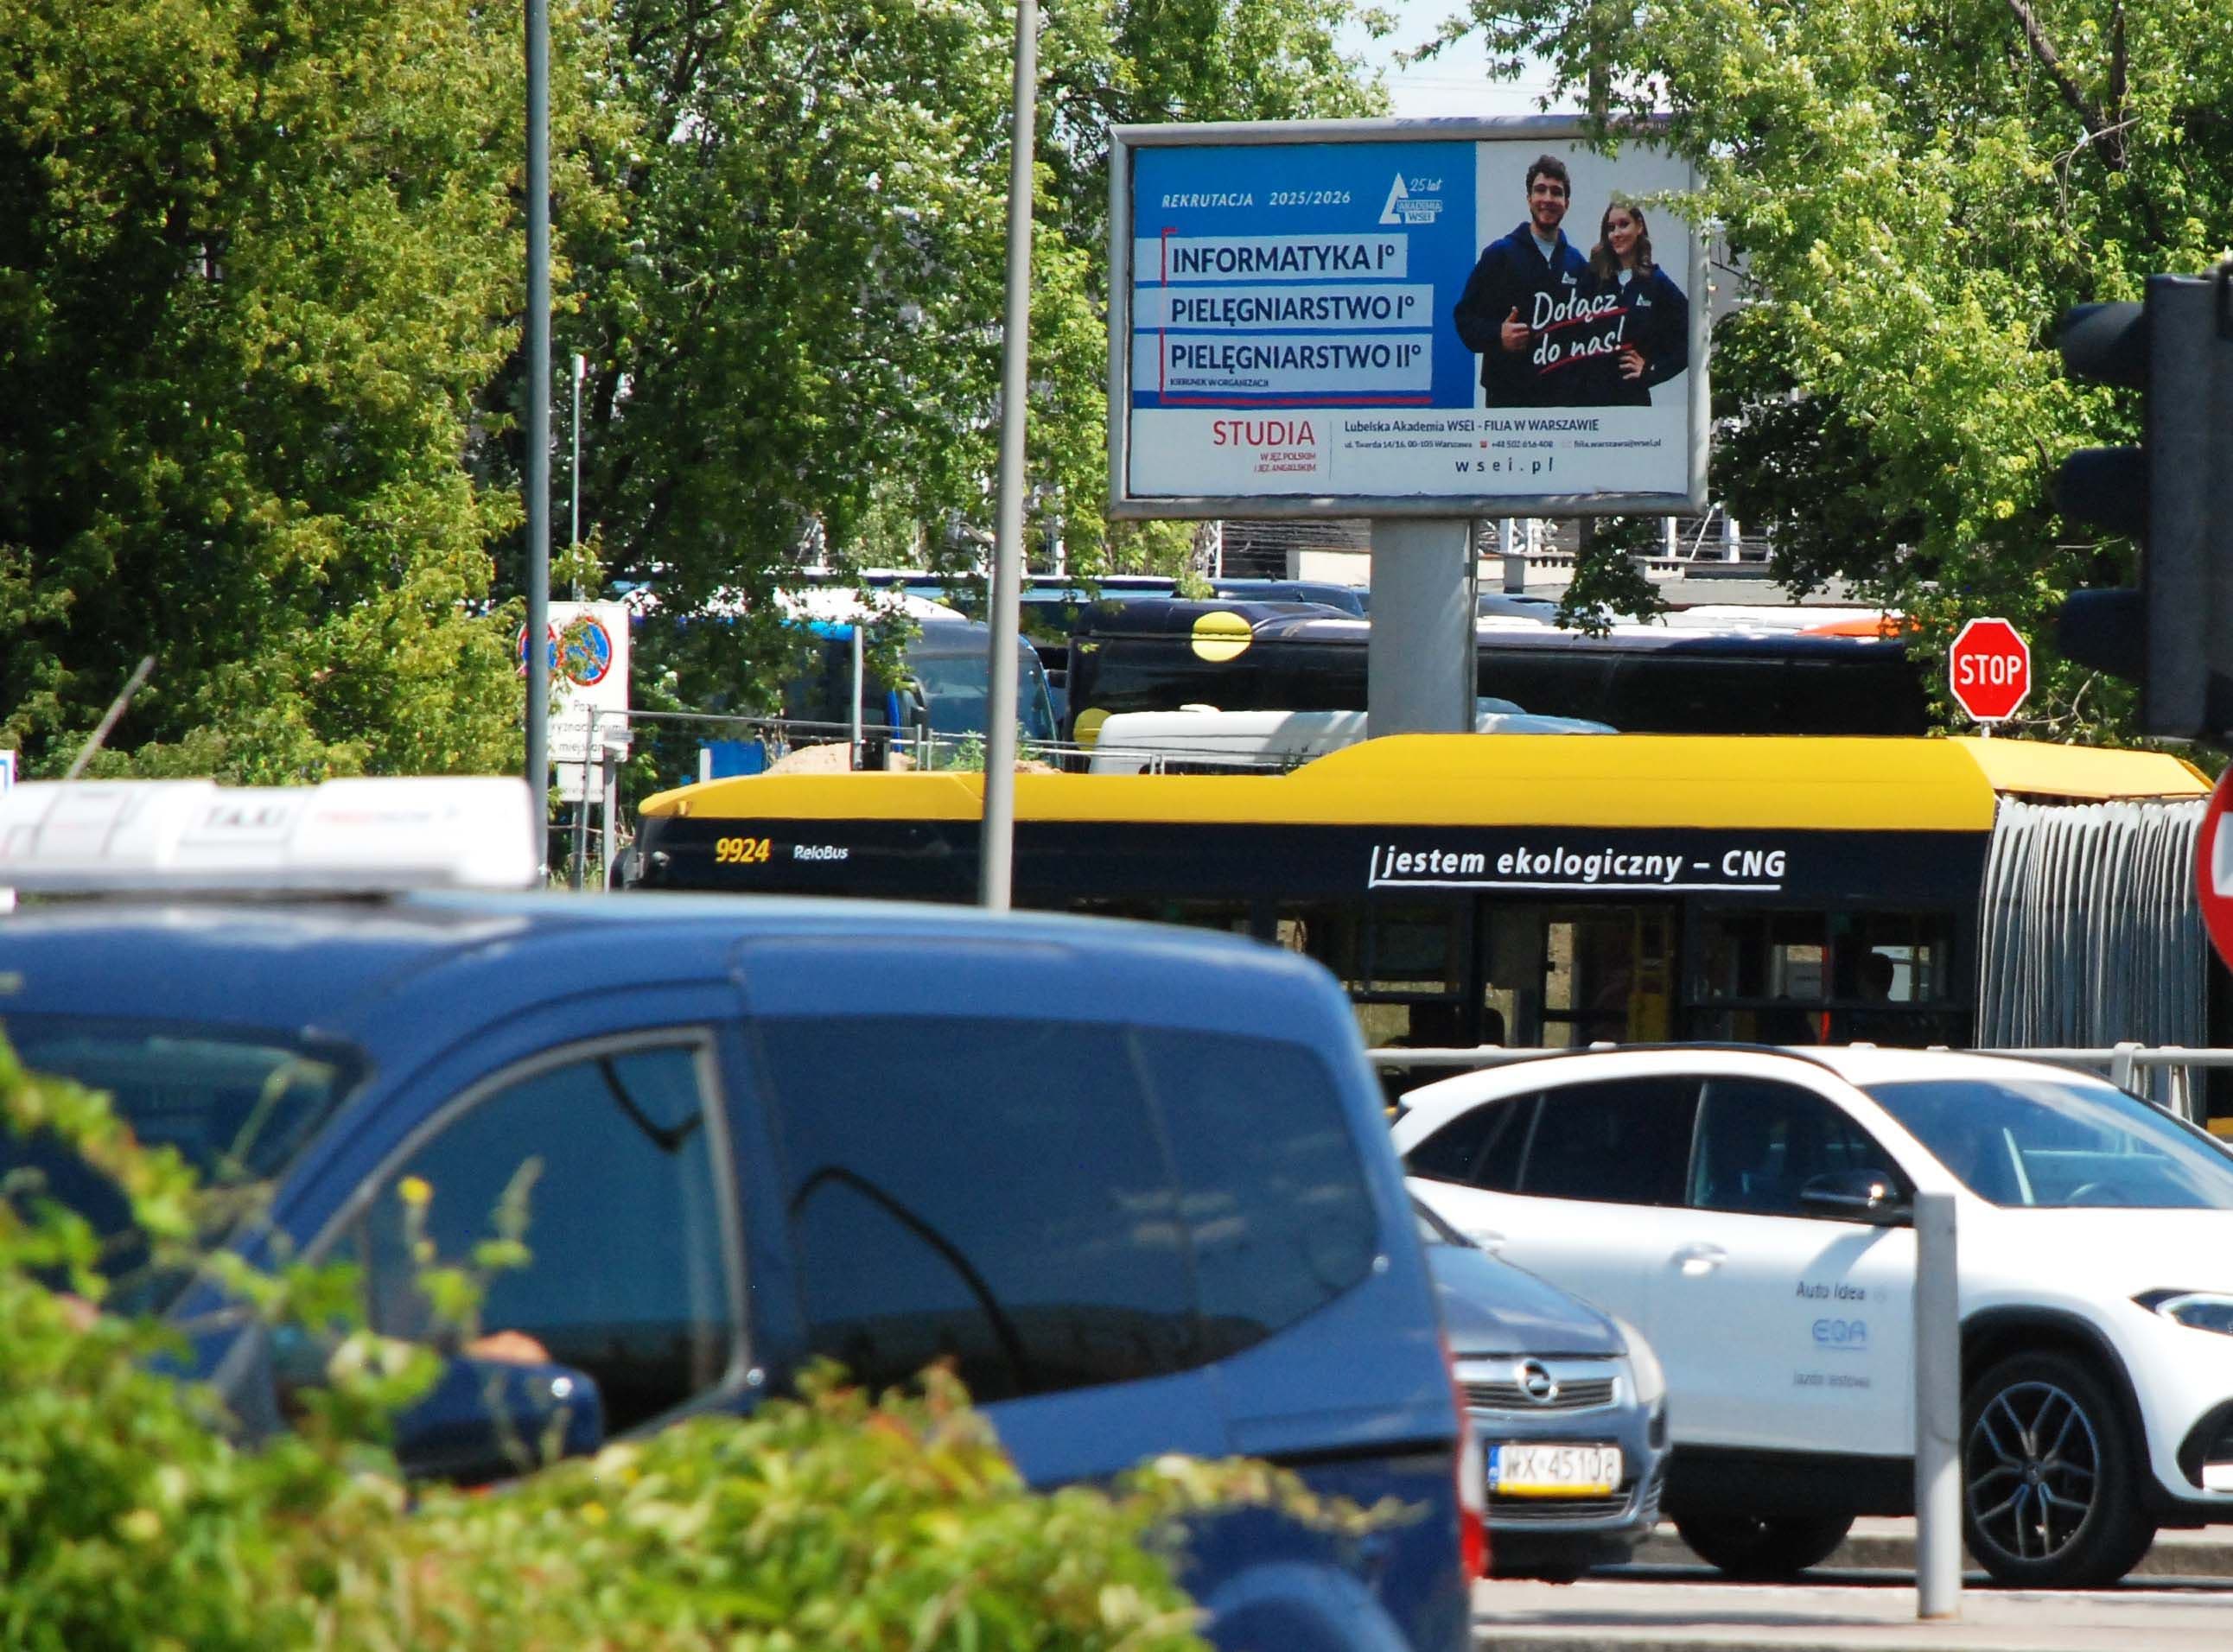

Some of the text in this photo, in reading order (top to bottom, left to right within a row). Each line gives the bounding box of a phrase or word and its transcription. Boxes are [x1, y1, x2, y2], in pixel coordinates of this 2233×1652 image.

[1409, 178, 1427, 192] 25
[1161, 191, 1352, 208] REKRUTACJA 2025/2026
[1172, 245, 1371, 273] INFORMATYKA
[1171, 295, 1391, 327] PIELĘGNIARSTWO
[1531, 288, 1619, 330] Dołącz
[1533, 315, 1625, 365] do nas!
[1171, 344, 1390, 374] PIELĘGNIARSTWO
[1212, 420, 1315, 447] STUDIA
[1344, 421, 1390, 433] Lubelska
[1392, 420, 1445, 433] Akademia
[1447, 420, 1475, 432] WSEI
[1484, 419, 1512, 432] FILIA
[1514, 419, 1526, 432] W
[1528, 419, 1600, 432] WARSZAWIE
[1959, 654, 2022, 685] STOP
[715, 837, 772, 862] 9924
[793, 844, 849, 860] ReloBus
[1384, 845, 1485, 878] jestem
[1497, 847, 1683, 883] ekologiczny
[1722, 850, 1786, 879] CNG
[1796, 1280, 1865, 1300] Auto Idea
